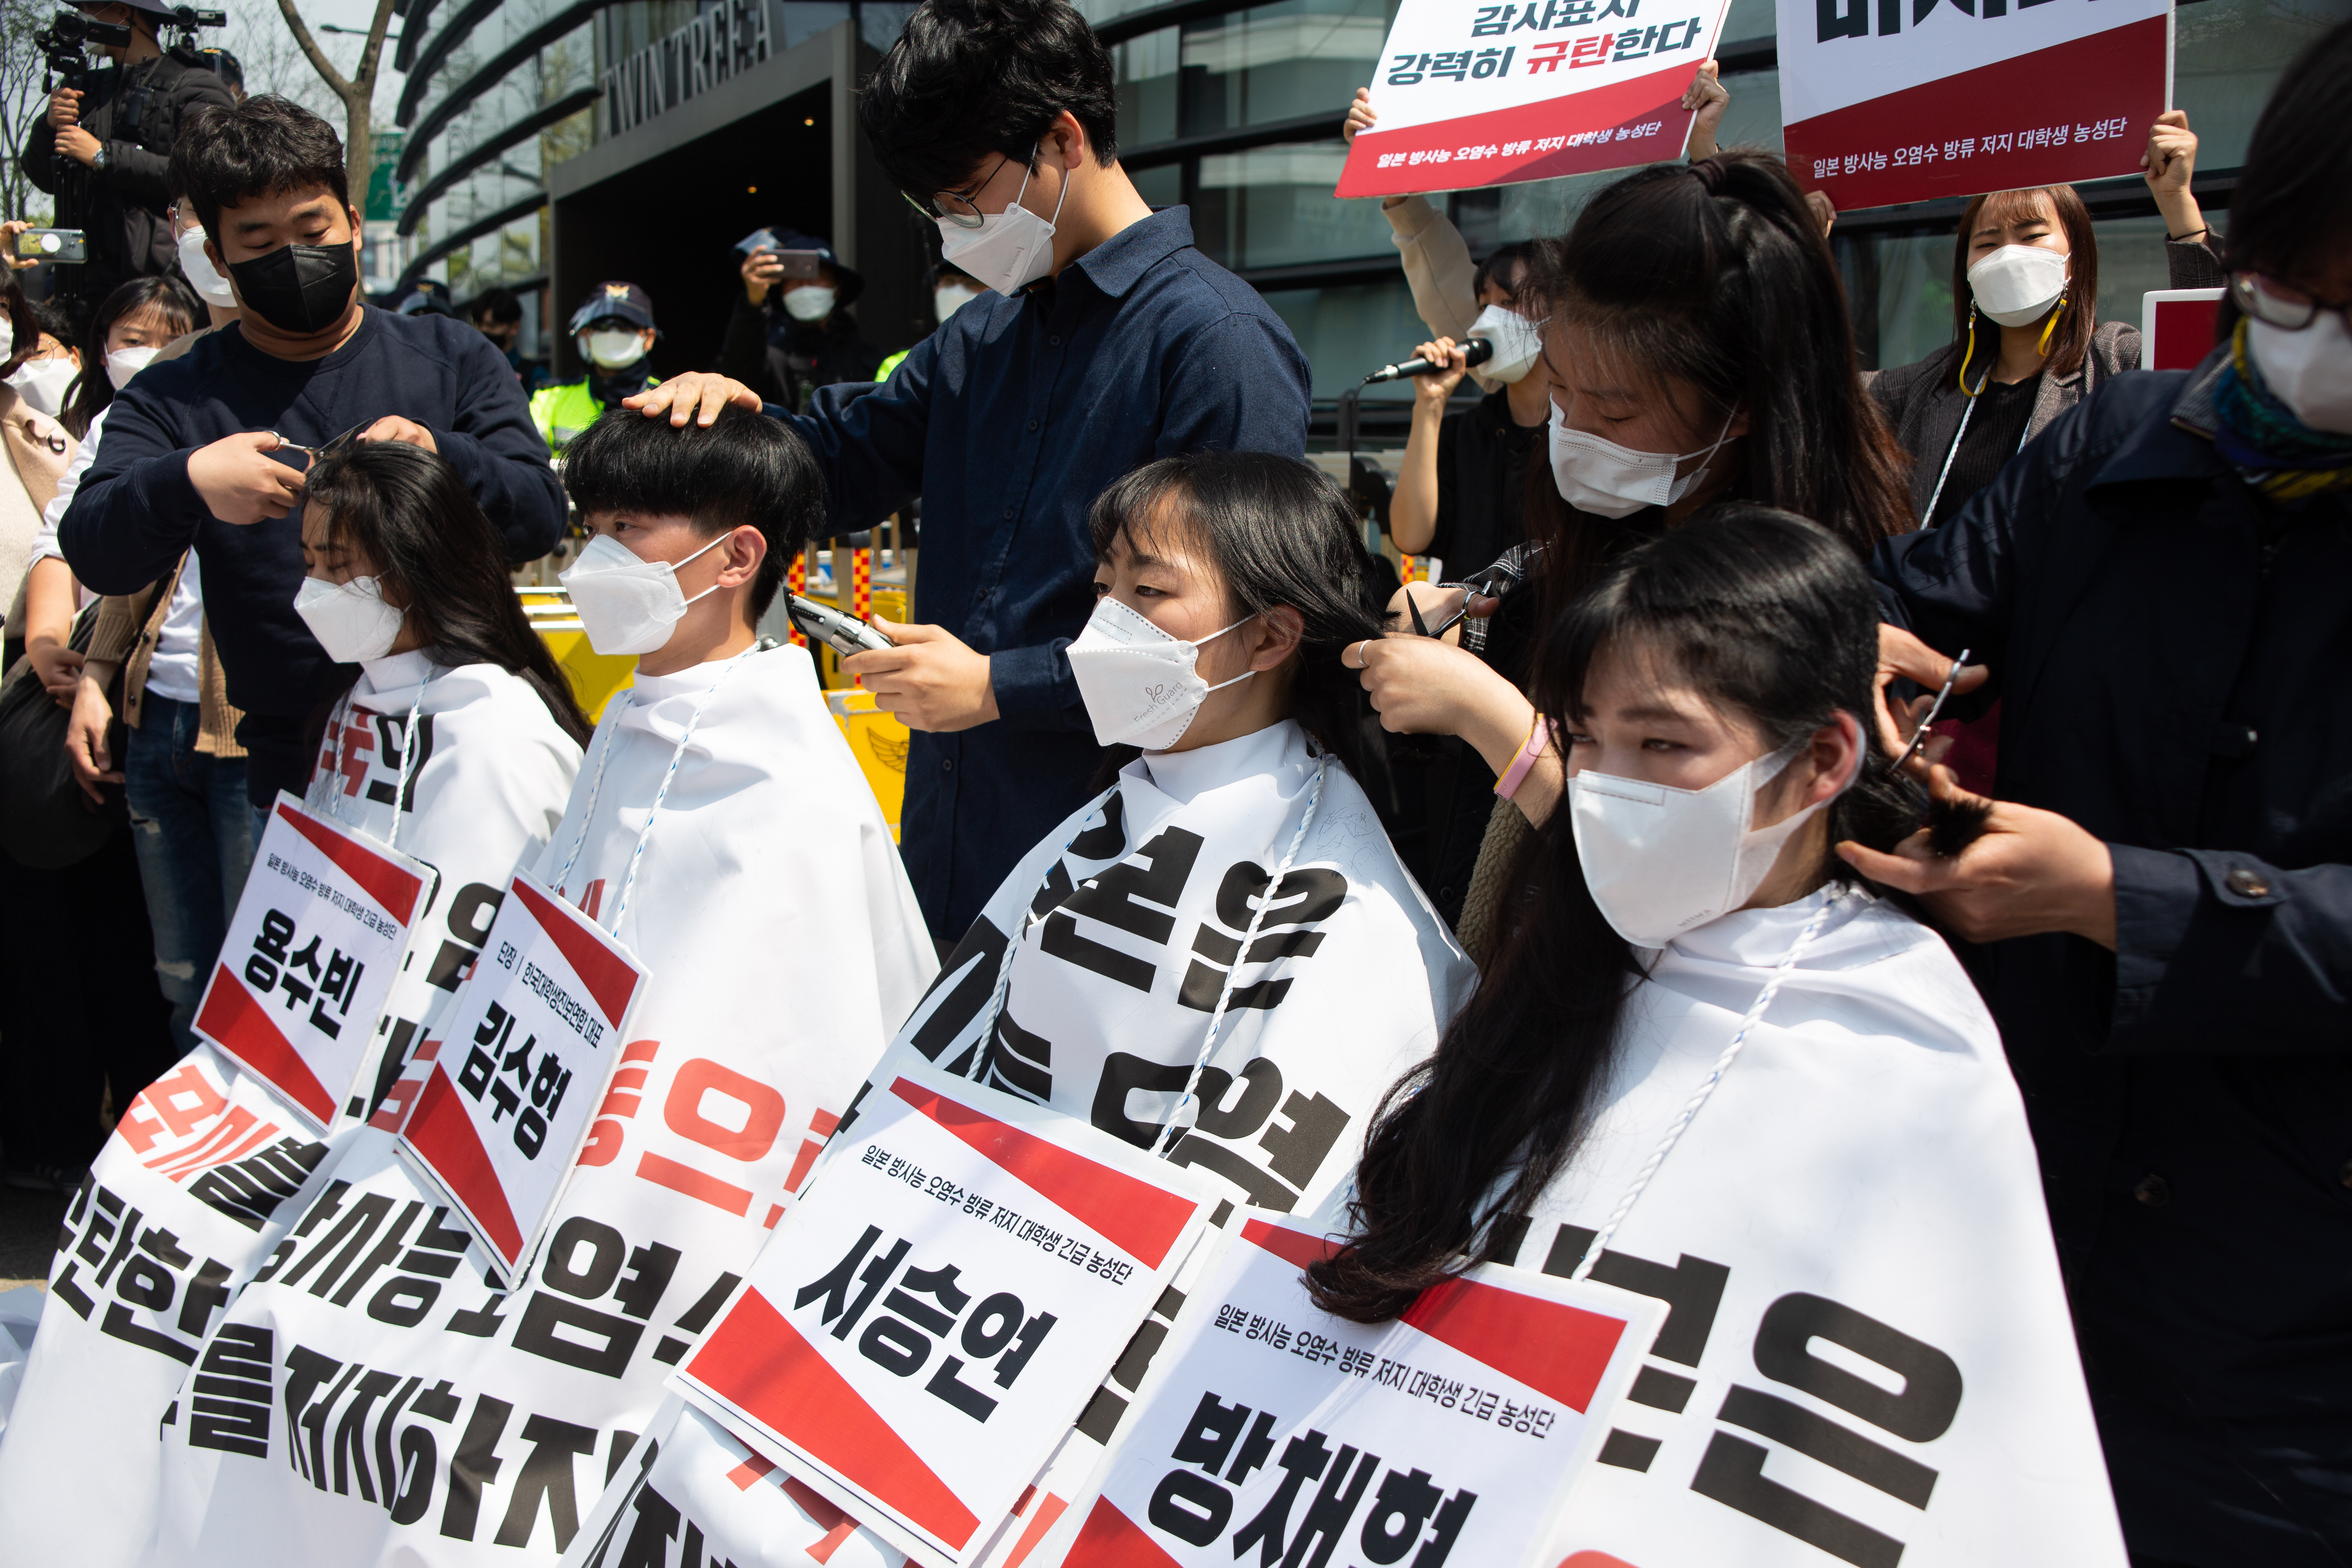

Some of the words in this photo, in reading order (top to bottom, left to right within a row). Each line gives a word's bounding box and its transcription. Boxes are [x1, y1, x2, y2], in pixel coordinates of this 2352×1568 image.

[599, 38, 666, 141] TWIN
[671, 0, 746, 107] TREE
[753, 0, 775, 68] A
[1387, 47, 1516, 86] 강력히
[1527, 17, 1702, 75] 규탄한다
[1376, 152, 1407, 168] 일본
[1408, 149, 1452, 166] 방사능
[1453, 145, 1498, 161] 오염수
[1501, 140, 1532, 157] 방류
[1534, 136, 1566, 151] 저지
[1566, 128, 1614, 148] 대학생
[1615, 121, 1662, 142] 농성단
[1814, 157, 1839, 179] 일본
[1844, 151, 1888, 174] 방사능
[1892, 145, 1938, 166] 오염수
[1944, 137, 1975, 160] 방류
[1980, 132, 2013, 154] 저지
[2018, 125, 2069, 149] 대학생
[2074, 117, 2127, 142] 농성단
[310, 703, 436, 813] 국의
[1134, 704, 1158, 725] Fresh
[1157, 681, 1183, 705] Guard
[267, 853, 282, 871] 일본
[280, 860, 300, 882] 방사능
[299, 871, 318, 892] 오염수
[318, 882, 332, 900] 방류
[330, 890, 346, 909] 저지
[344, 898, 365, 920] 대학생
[363, 909, 379, 929] 긴급
[376, 917, 397, 940] 농성단
[245, 908, 365, 1041] 용수빈
[497, 940, 518, 969] 단장
[521, 961, 589, 1035] 한국대학생진보연합
[584, 1016, 604, 1049] 대표
[457, 999, 573, 1160] 김수형
[861, 1145, 892, 1170] 일본
[887, 1157, 927, 1188] 방사능
[924, 1176, 965, 1205] 오염수
[962, 1193, 994, 1220] 방류
[989, 1206, 1022, 1234] 저지
[1016, 1219, 1063, 1252] 대학생
[1058, 1238, 1091, 1266] 긴급
[1086, 1252, 1134, 1285] 농성단
[793, 1224, 1058, 1424] 서승연
[1214, 1304, 1249, 1334] 일본
[1245, 1314, 1292, 1350] 방사능
[1290, 1330, 1340, 1366] 오염수
[1338, 1346, 1375, 1378] 방류
[1371, 1357, 1412, 1391] 저지
[1407, 1370, 1463, 1408] 대학생
[1459, 1386, 1500, 1421] 긴급
[1497, 1398, 1556, 1439] 농성단
